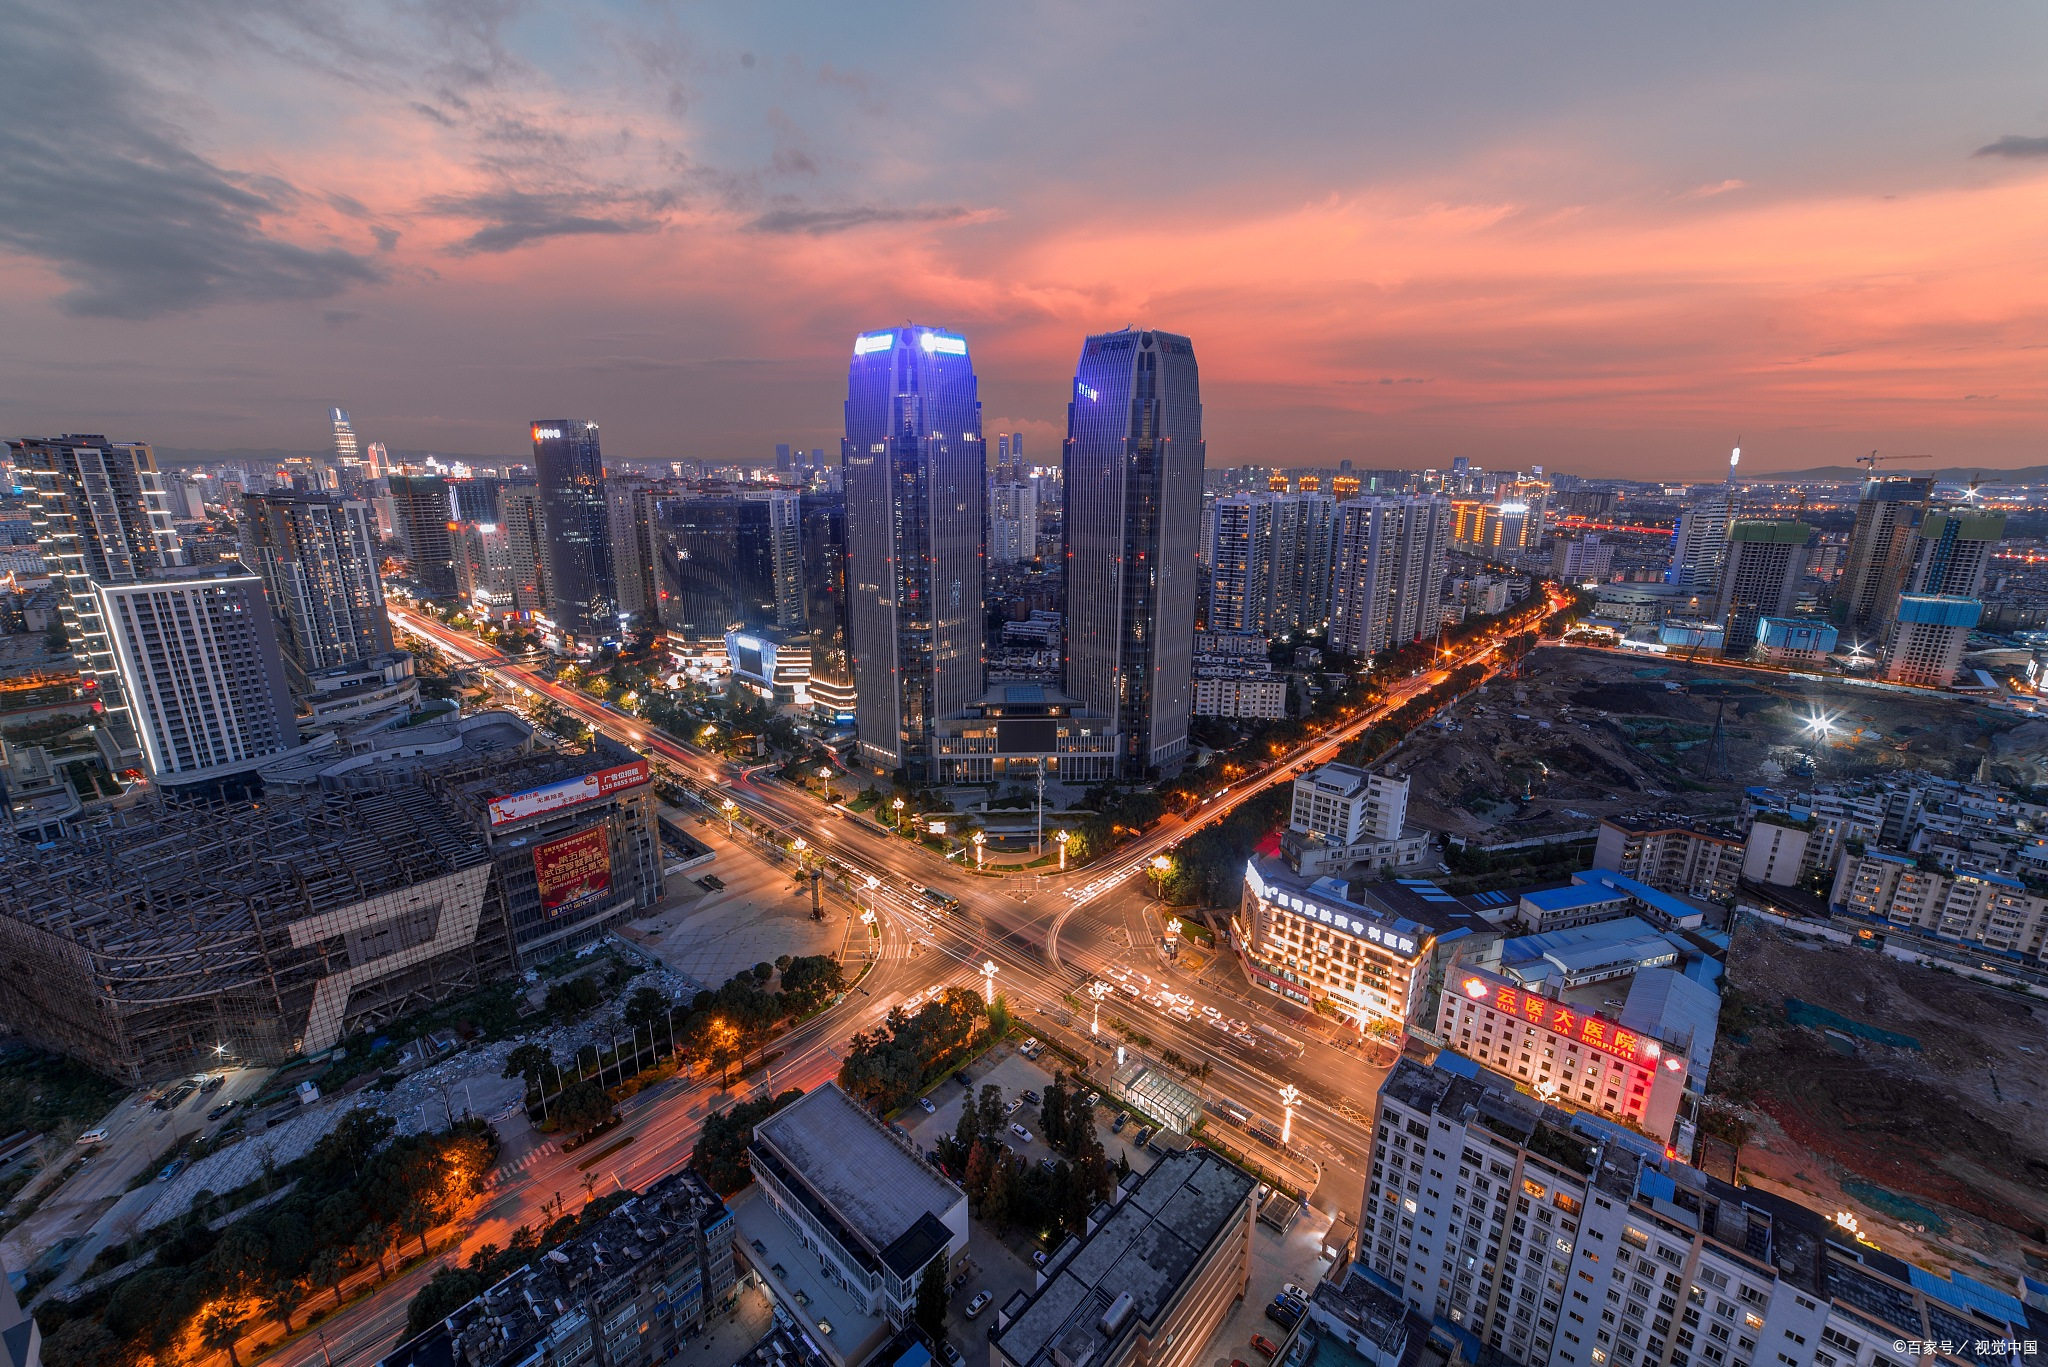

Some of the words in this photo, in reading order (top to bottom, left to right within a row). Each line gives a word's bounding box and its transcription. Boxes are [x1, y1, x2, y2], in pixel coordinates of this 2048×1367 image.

[604, 767, 639, 783] 广告位招租
[1278, 892, 1414, 953] 昆明皮肤病专科医院
[1496, 986, 1637, 1053] 云医大医院
[1496, 1001, 1517, 1014] YUN
[1529, 1013, 1539, 1023] YI
[1553, 1024, 1569, 1035] DA
[1581, 1034, 1635, 1060] HOSPITAL
